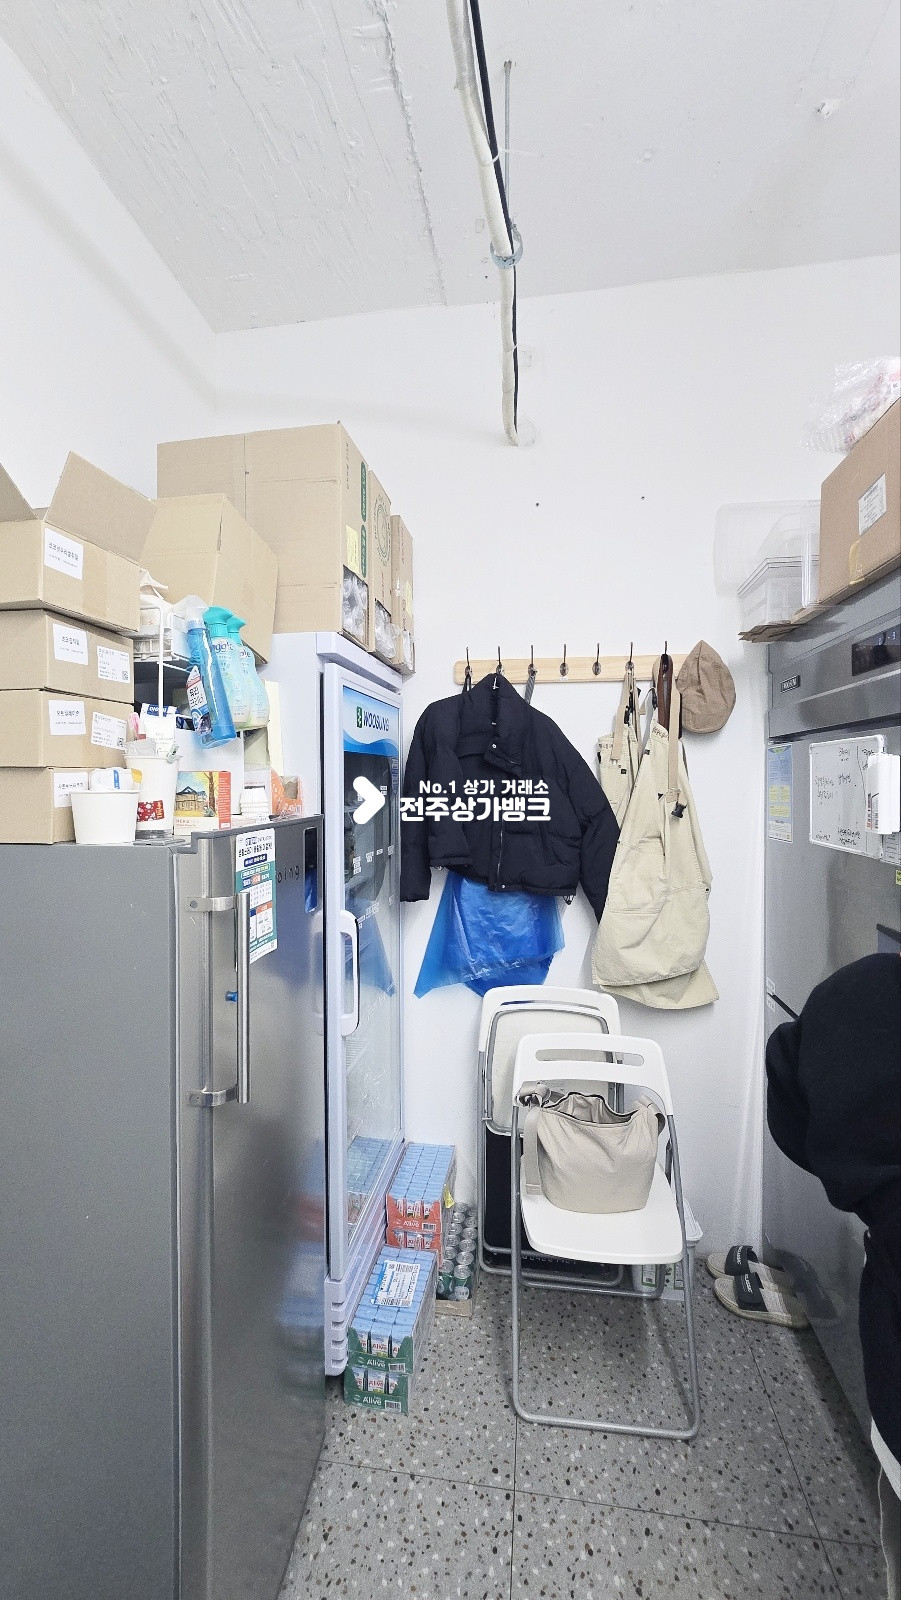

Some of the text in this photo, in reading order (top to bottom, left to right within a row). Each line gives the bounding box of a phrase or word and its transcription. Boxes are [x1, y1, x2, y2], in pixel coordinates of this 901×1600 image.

[363, 710, 389, 732] WOOSUNG
[367, 1359, 386, 1368] Alive
[362, 1396, 382, 1406] Alive
